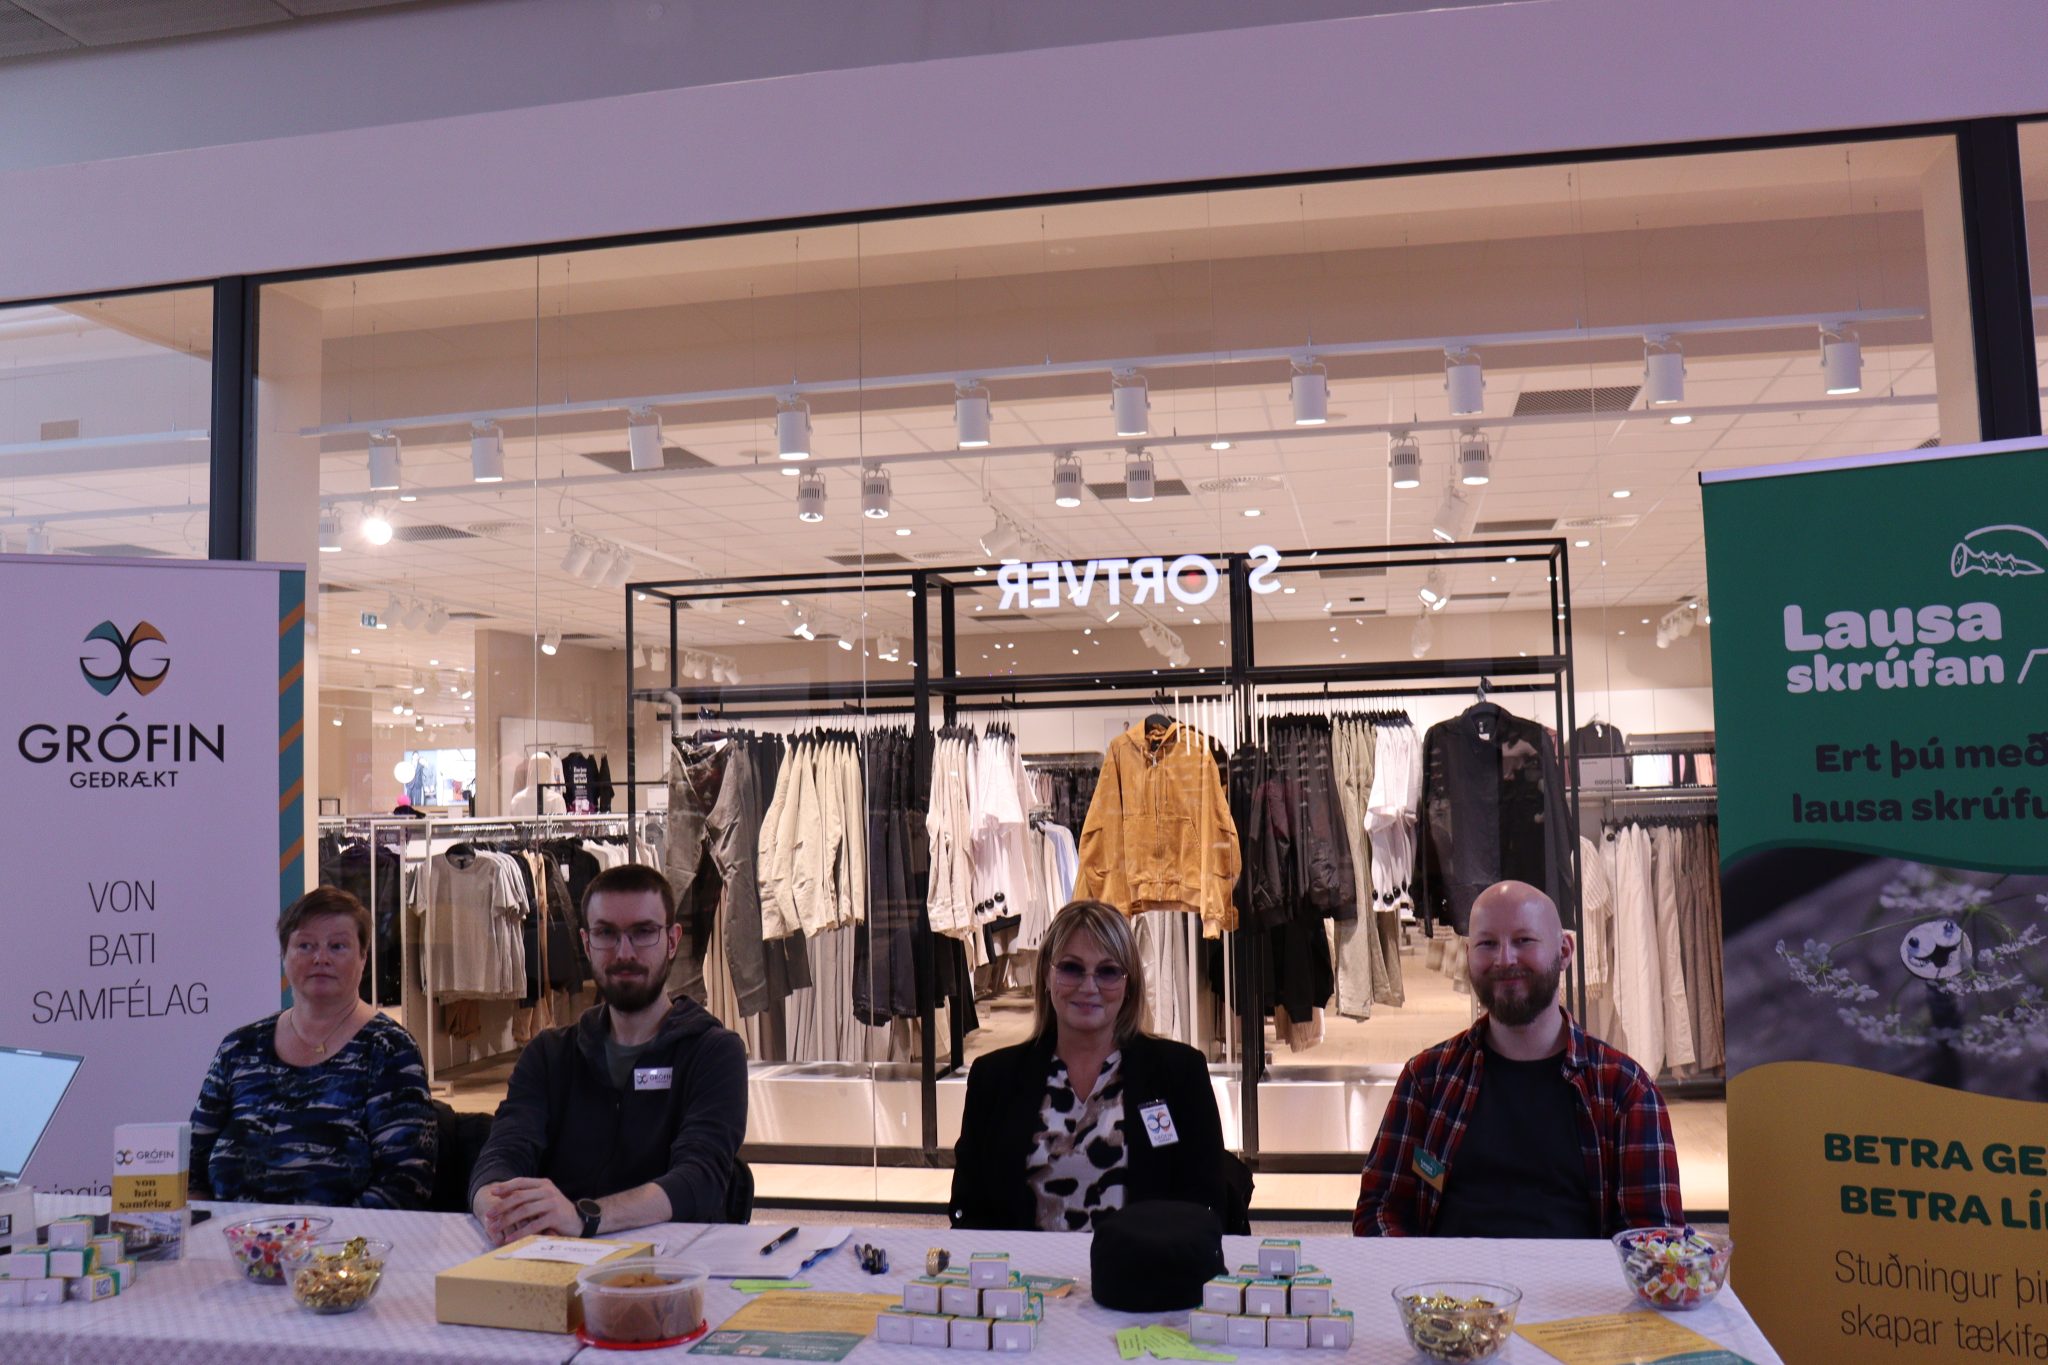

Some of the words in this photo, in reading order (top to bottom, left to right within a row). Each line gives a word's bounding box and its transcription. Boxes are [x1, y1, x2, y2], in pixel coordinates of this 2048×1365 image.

[1783, 602, 2002, 651] Lausa
[1786, 646, 2005, 693] skrúfan
[18, 711, 225, 764] GRÓFIN
[1815, 743, 1882, 773] Ert
[1890, 736, 1945, 779] þú
[69, 770, 179, 789] GEÐRÆKT
[1792, 793, 1903, 823] lausa
[88, 880, 155, 913] VON
[89, 932, 155, 967] BATI
[32, 978, 209, 1024] SAMFÉLAG
[136, 1149, 175, 1160] GRÓFIN
[1824, 1133, 1974, 1172] BETRA
[1840, 1185, 1992, 1226] BETRA
[2001, 1189, 2048, 1230] LÍ
[1835, 1250, 2002, 1303] Stuðningur
[2015, 1268, 2048, 1309] þi
[1841, 1304, 1943, 1348] skapar
